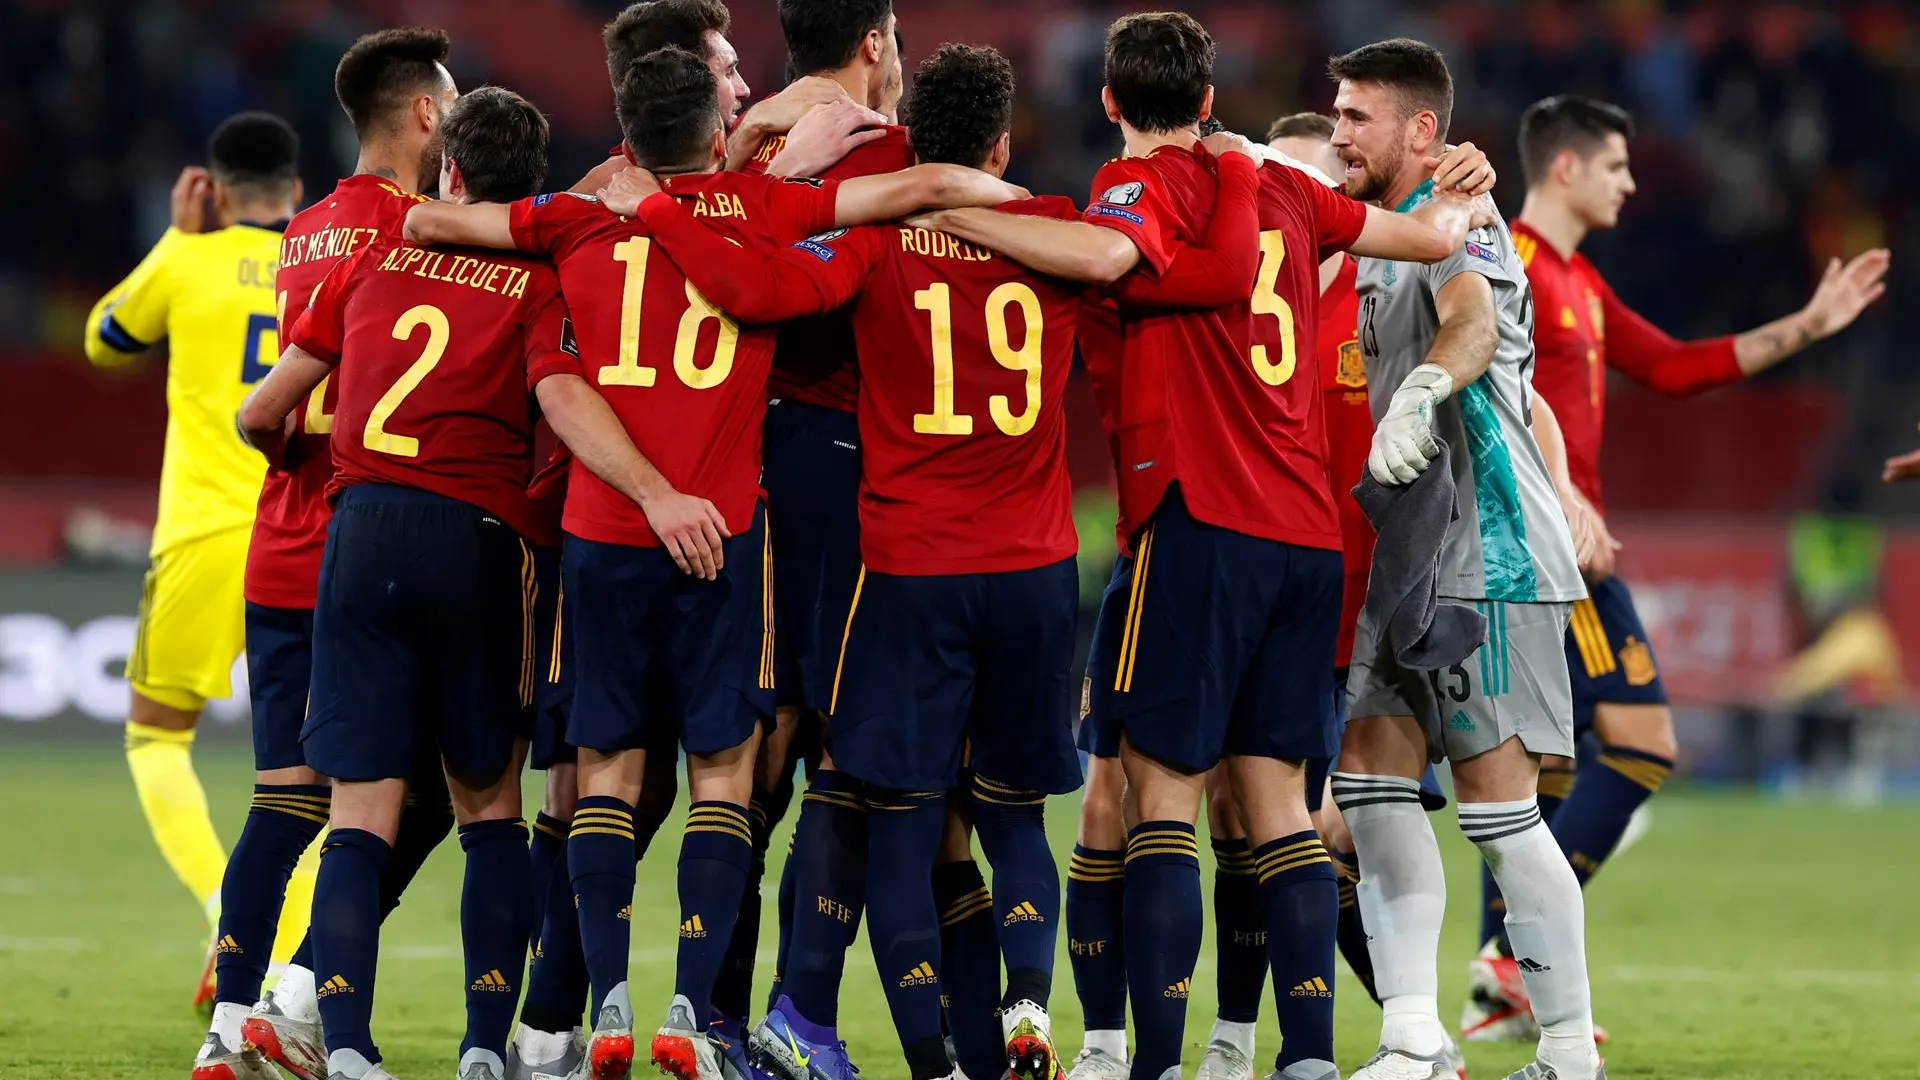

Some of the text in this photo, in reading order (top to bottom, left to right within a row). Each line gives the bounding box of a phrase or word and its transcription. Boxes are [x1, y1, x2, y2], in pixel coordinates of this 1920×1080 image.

[692, 191, 748, 221] ALBA
[1102, 207, 1144, 224] RESPECT
[377, 247, 531, 300] AZPILICUETA
[913, 281, 1044, 437] 19
[363, 304, 450, 458] 2
[818, 895, 853, 924] RFEF
[1003, 914, 1045, 927] adidas
[1071, 938, 1107, 956] RFEF
[1234, 929, 1268, 947] RFEF
[471, 983, 512, 993] adidas
[900, 975, 938, 988] adidas
[1289, 988, 1333, 998] adidas
